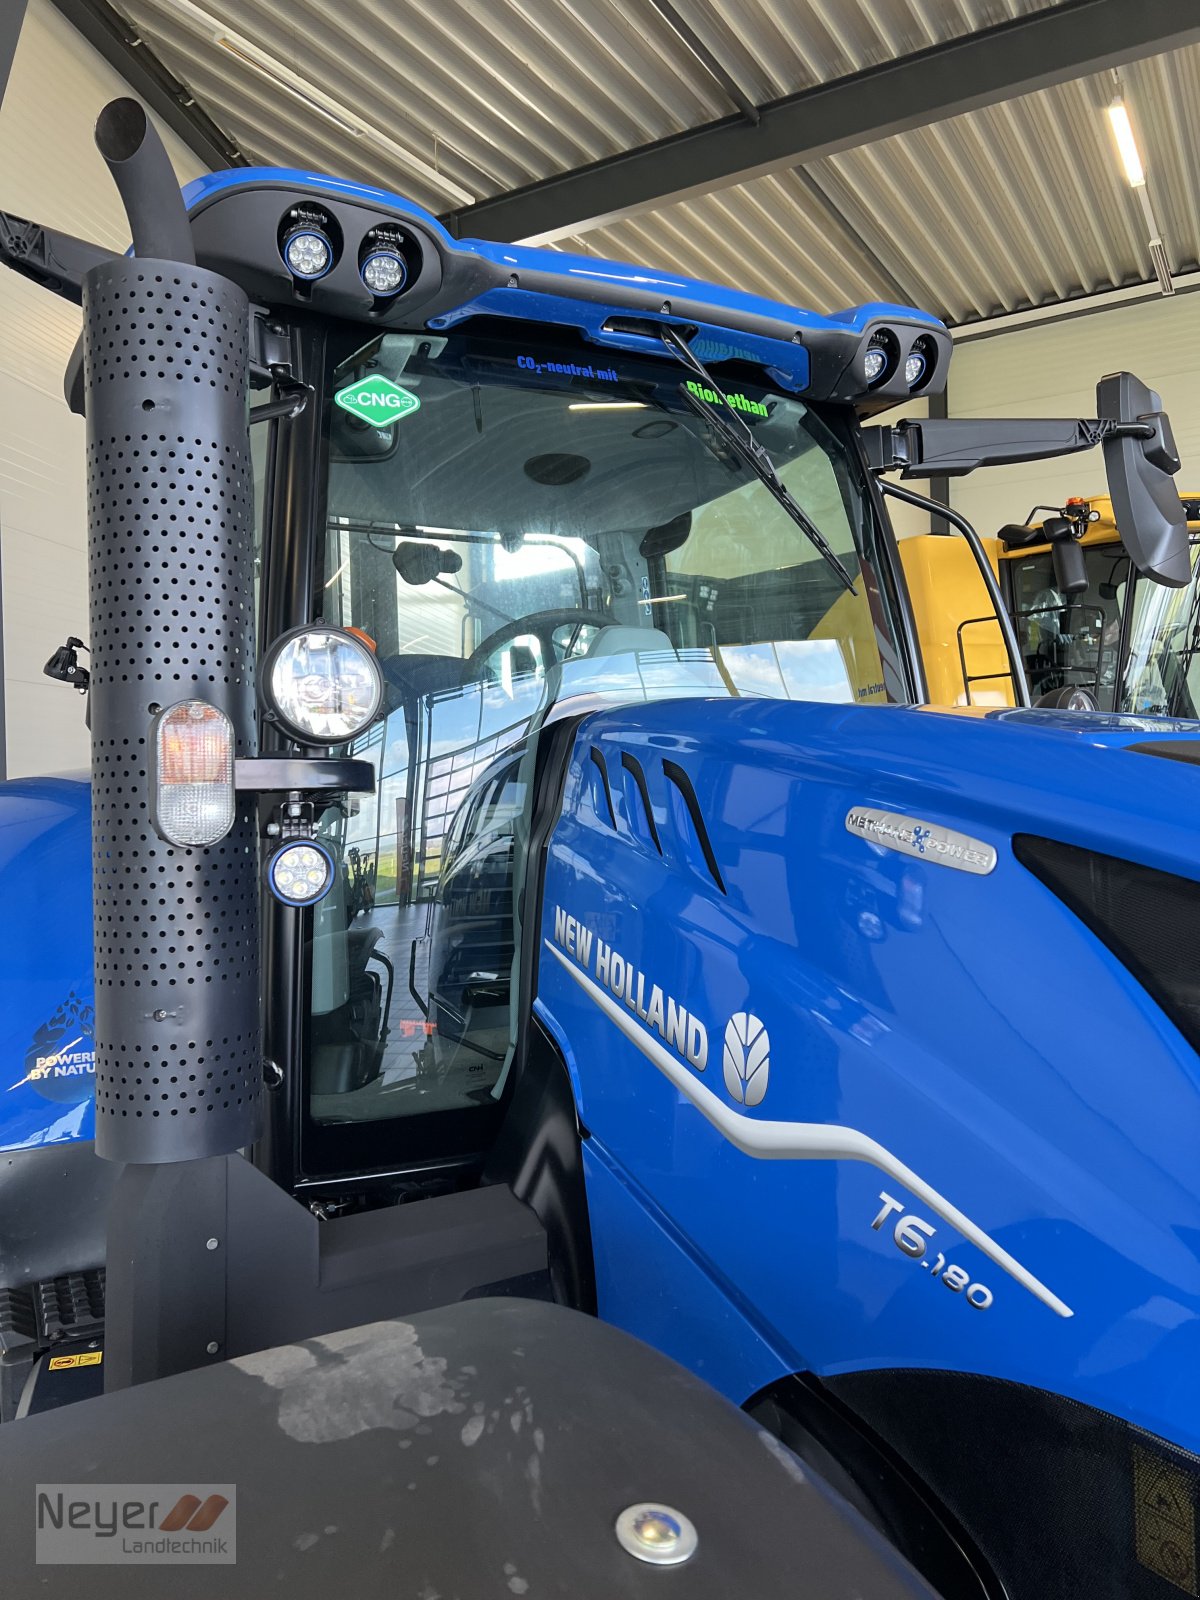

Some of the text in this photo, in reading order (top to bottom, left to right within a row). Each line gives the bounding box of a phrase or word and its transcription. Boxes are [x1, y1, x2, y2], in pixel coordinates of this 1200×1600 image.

[597, 368, 619, 382] mit
[357, 391, 401, 408] CNG
[926, 838, 989, 867] POWER
[554, 904, 708, 1073] NEW HOLLAND
[30, 1062, 96, 1080] BY NATU
[871, 1191, 993, 1310] T6.180
